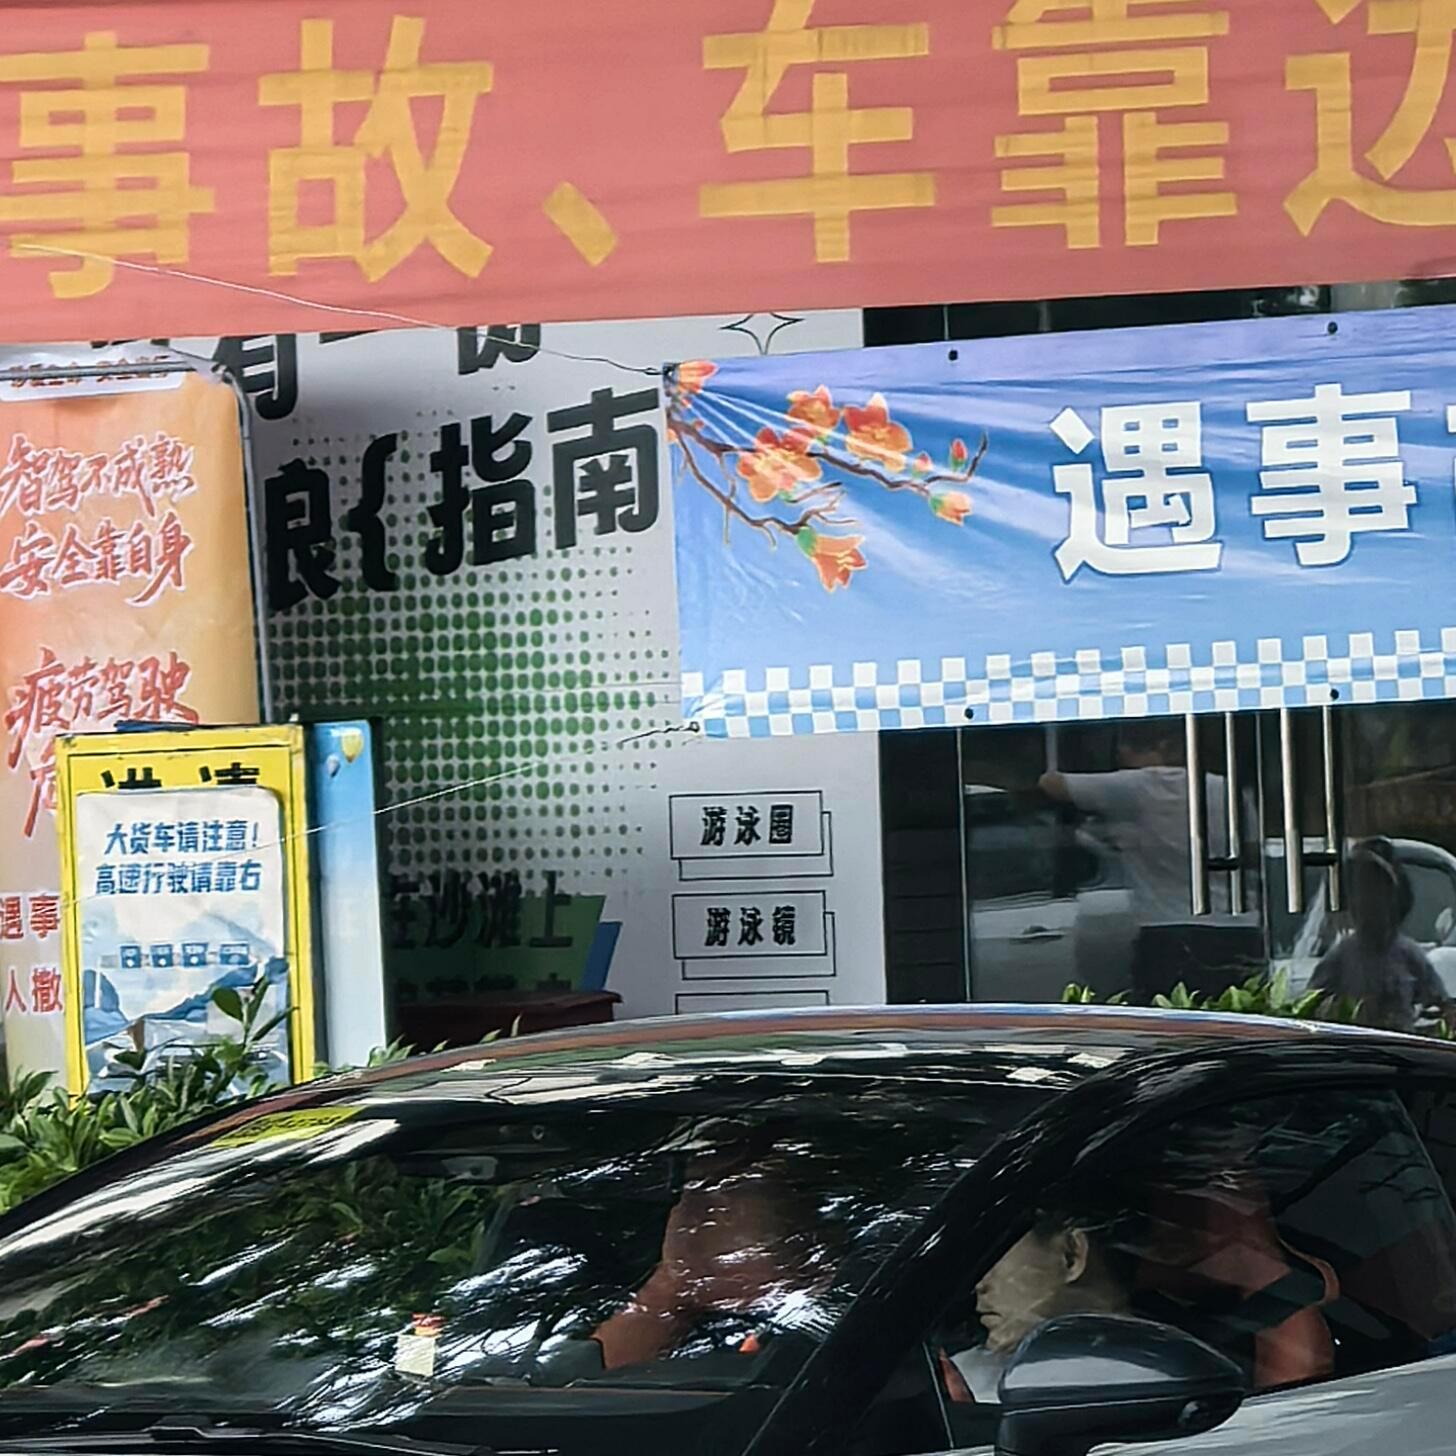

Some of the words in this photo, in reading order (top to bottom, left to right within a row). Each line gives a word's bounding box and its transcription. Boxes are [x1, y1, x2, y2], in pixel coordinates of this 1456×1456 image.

[4, 647, 200, 769] 疲劳驾驶
[104, 820, 260, 855] 大货车请注意！
[700, 803, 793, 847] 游泳圈
[95, 859, 262, 895] 高速行驶请靠右
[705, 905, 797, 946] 游泳镜
